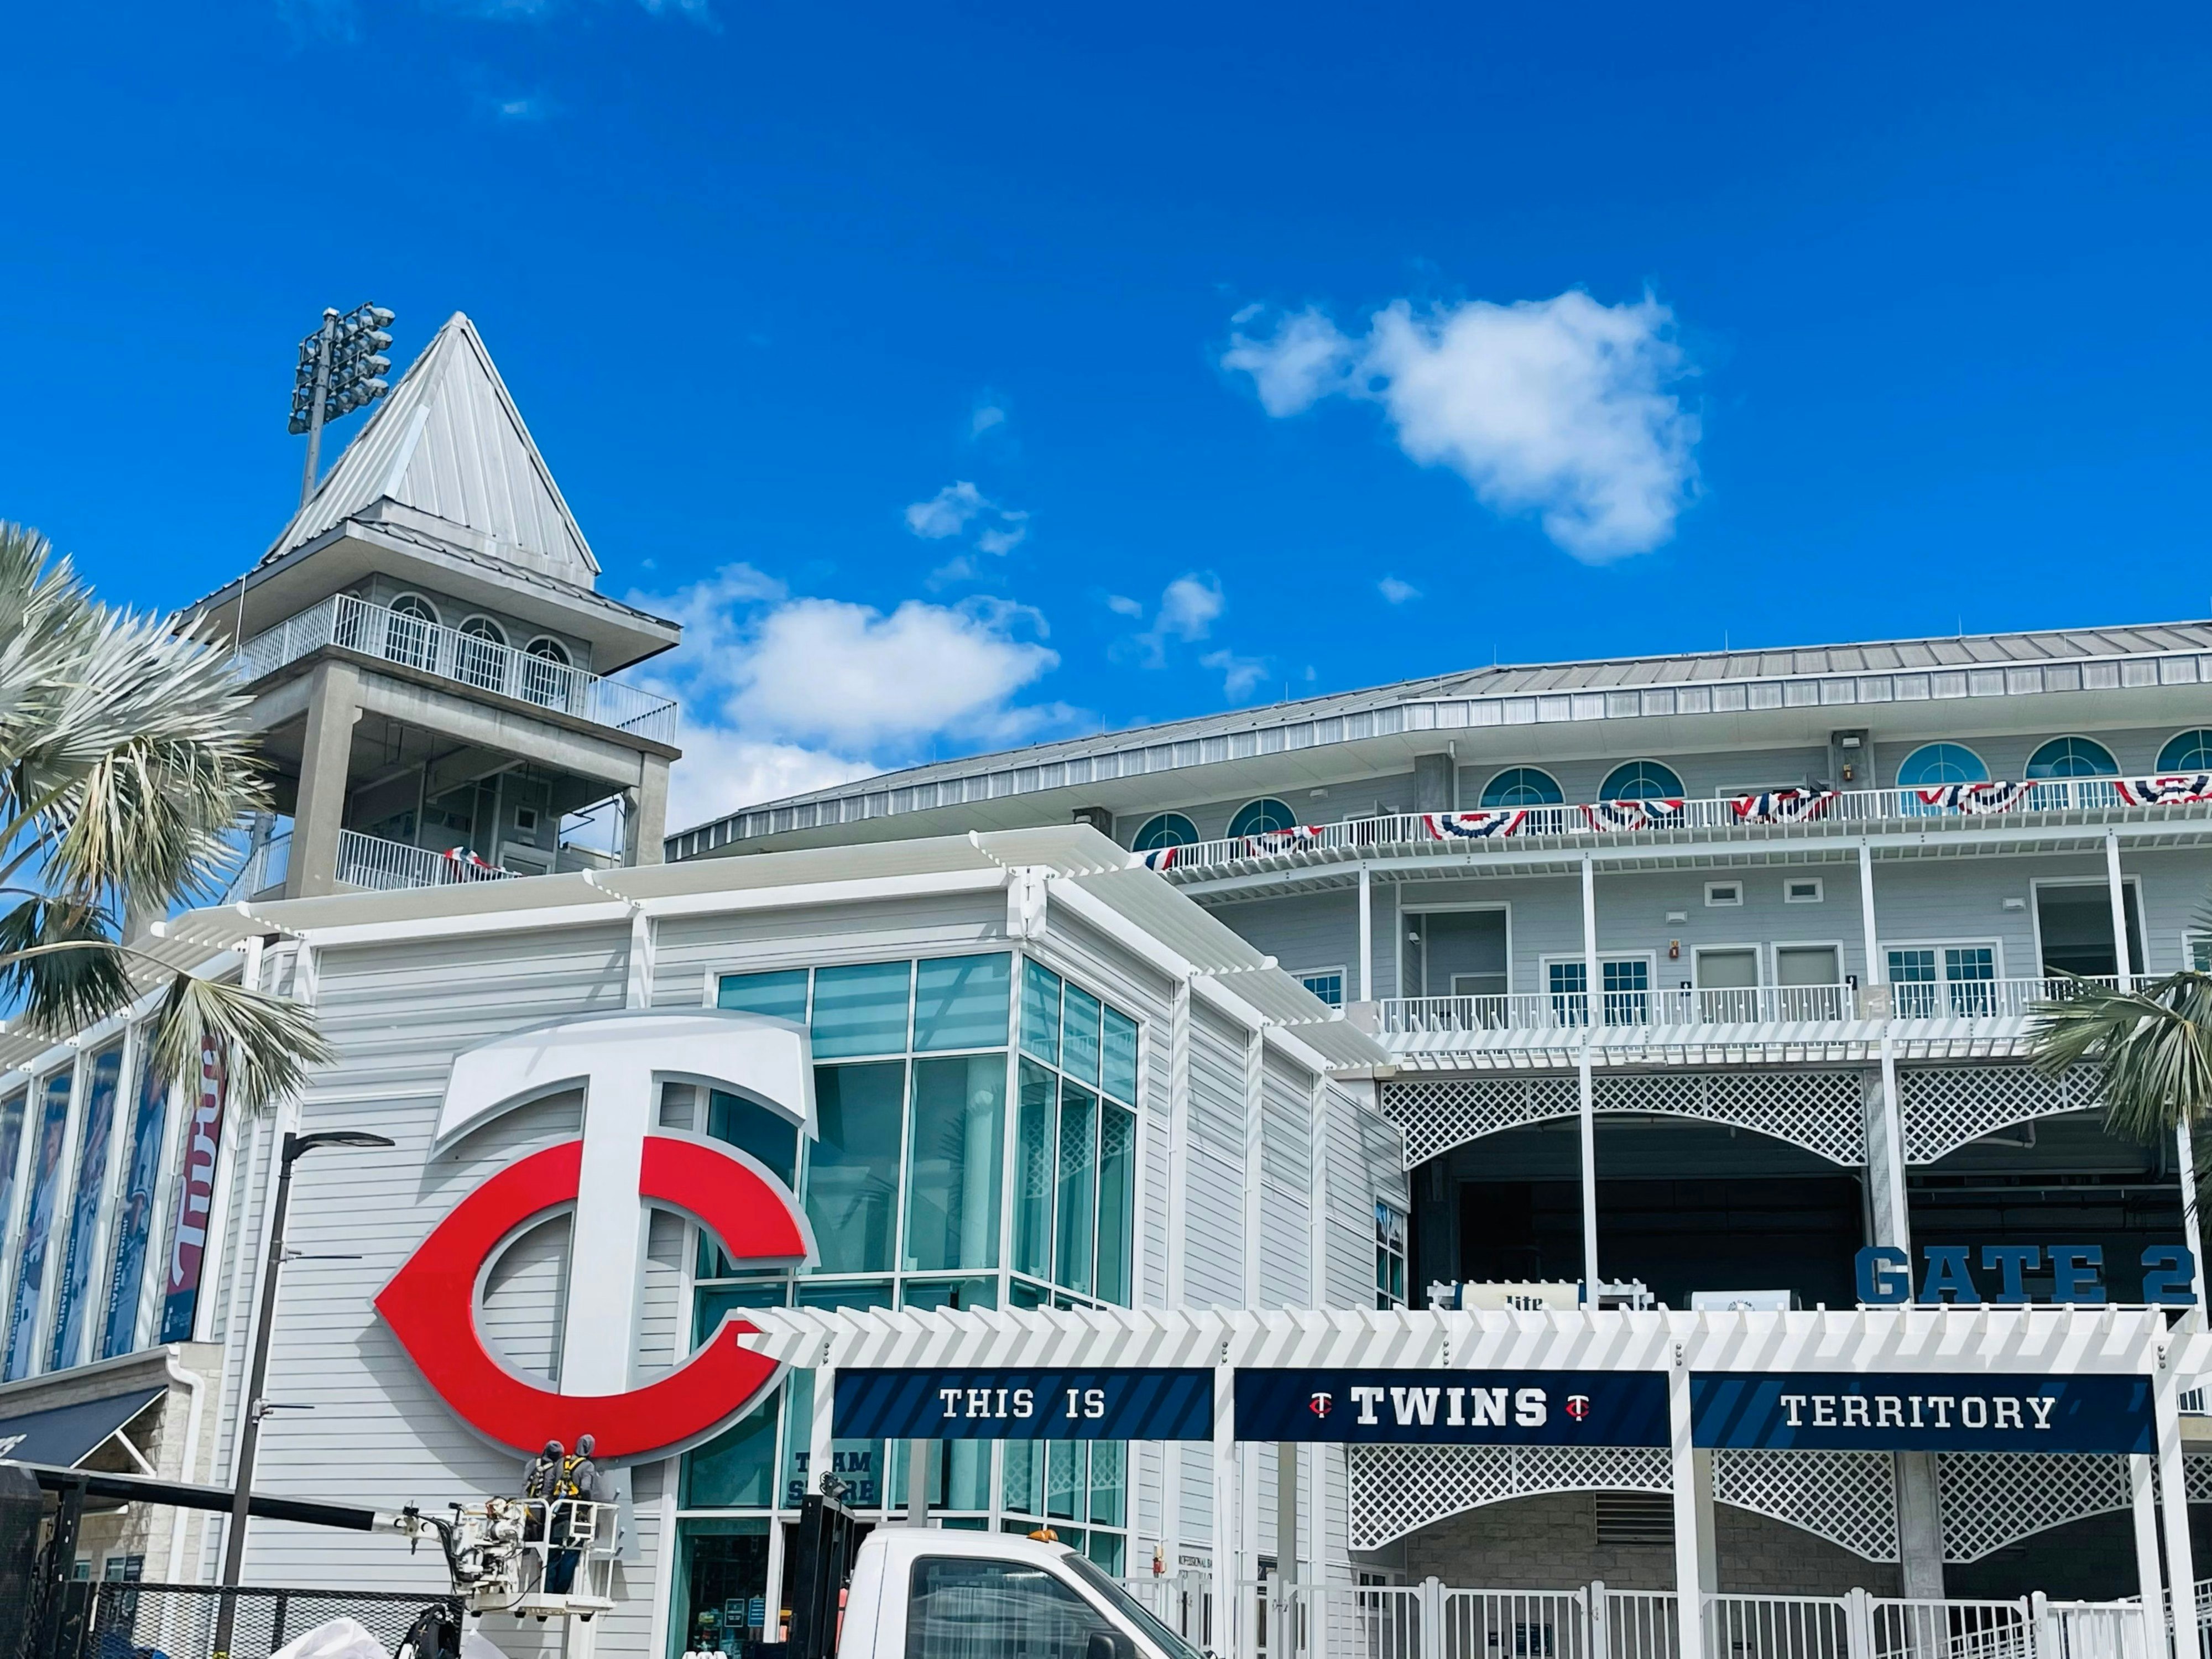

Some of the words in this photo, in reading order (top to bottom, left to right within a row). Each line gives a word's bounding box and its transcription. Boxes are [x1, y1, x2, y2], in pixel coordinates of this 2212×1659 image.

[110, 1261, 123, 1313] DURAN
[1855, 1245, 2106, 1304] GATE
[2141, 1245, 2198, 1304] 2
[56, 1267, 71, 1334] MIRANDA
[940, 1389, 1034, 1418] THIS
[1066, 1389, 1105, 1418] IS
[1350, 1386, 1547, 1427] TWINS
[1780, 1395, 2056, 1429] TERRITORY
[795, 1452, 872, 1473] TAM
[788, 1480, 875, 1501] SRE
